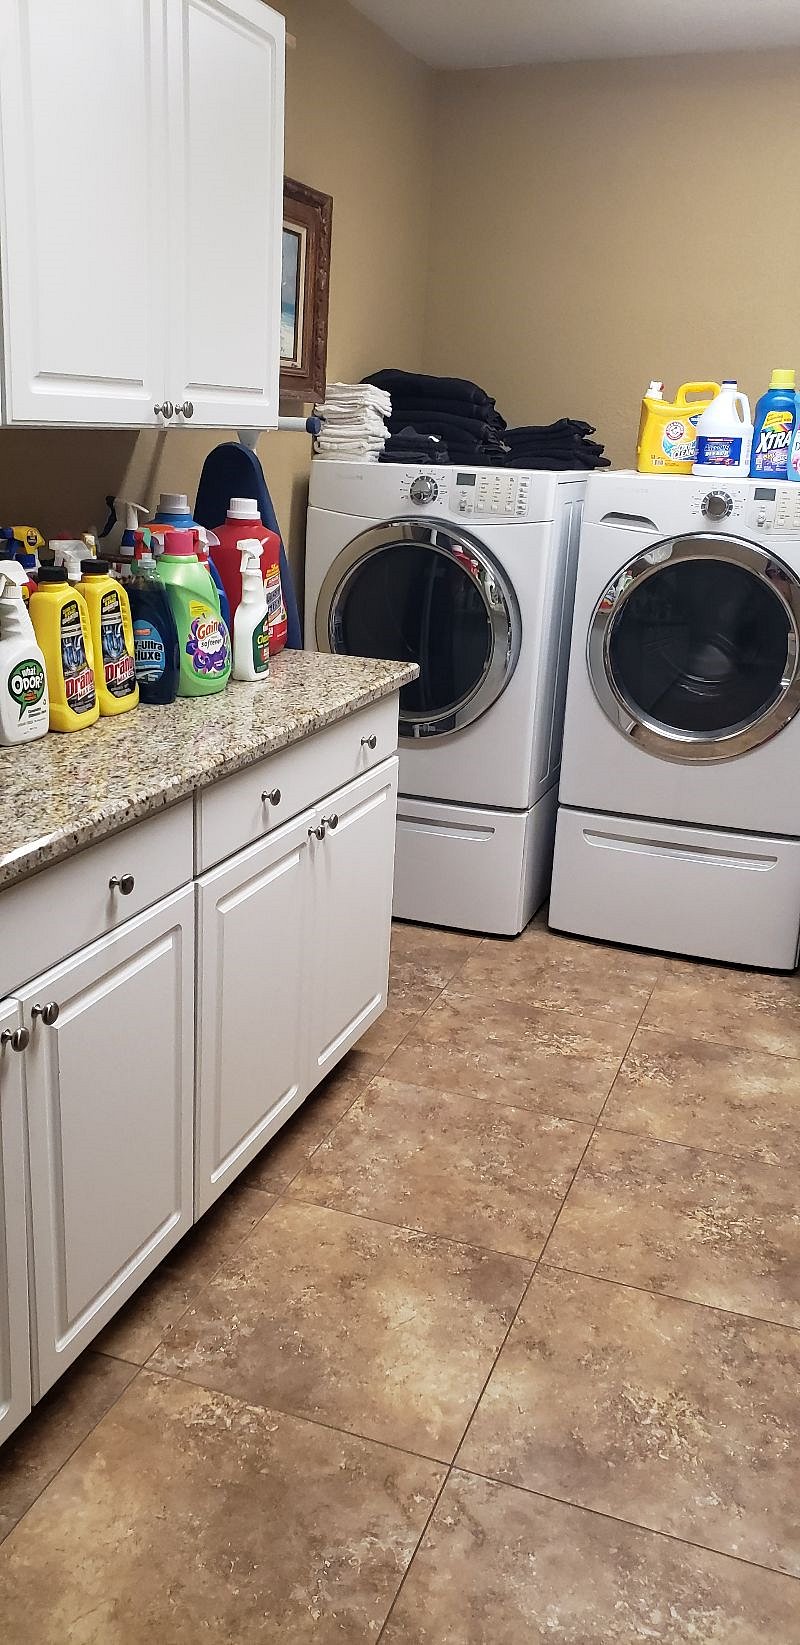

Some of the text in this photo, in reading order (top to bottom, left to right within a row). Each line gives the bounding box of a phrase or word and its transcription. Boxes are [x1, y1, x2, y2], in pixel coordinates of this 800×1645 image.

[756, 430, 792, 454] XTRA
[197, 620, 219, 640] Gain
[21, 666, 37, 677] what
[11, 673, 44, 695] ODOR?
